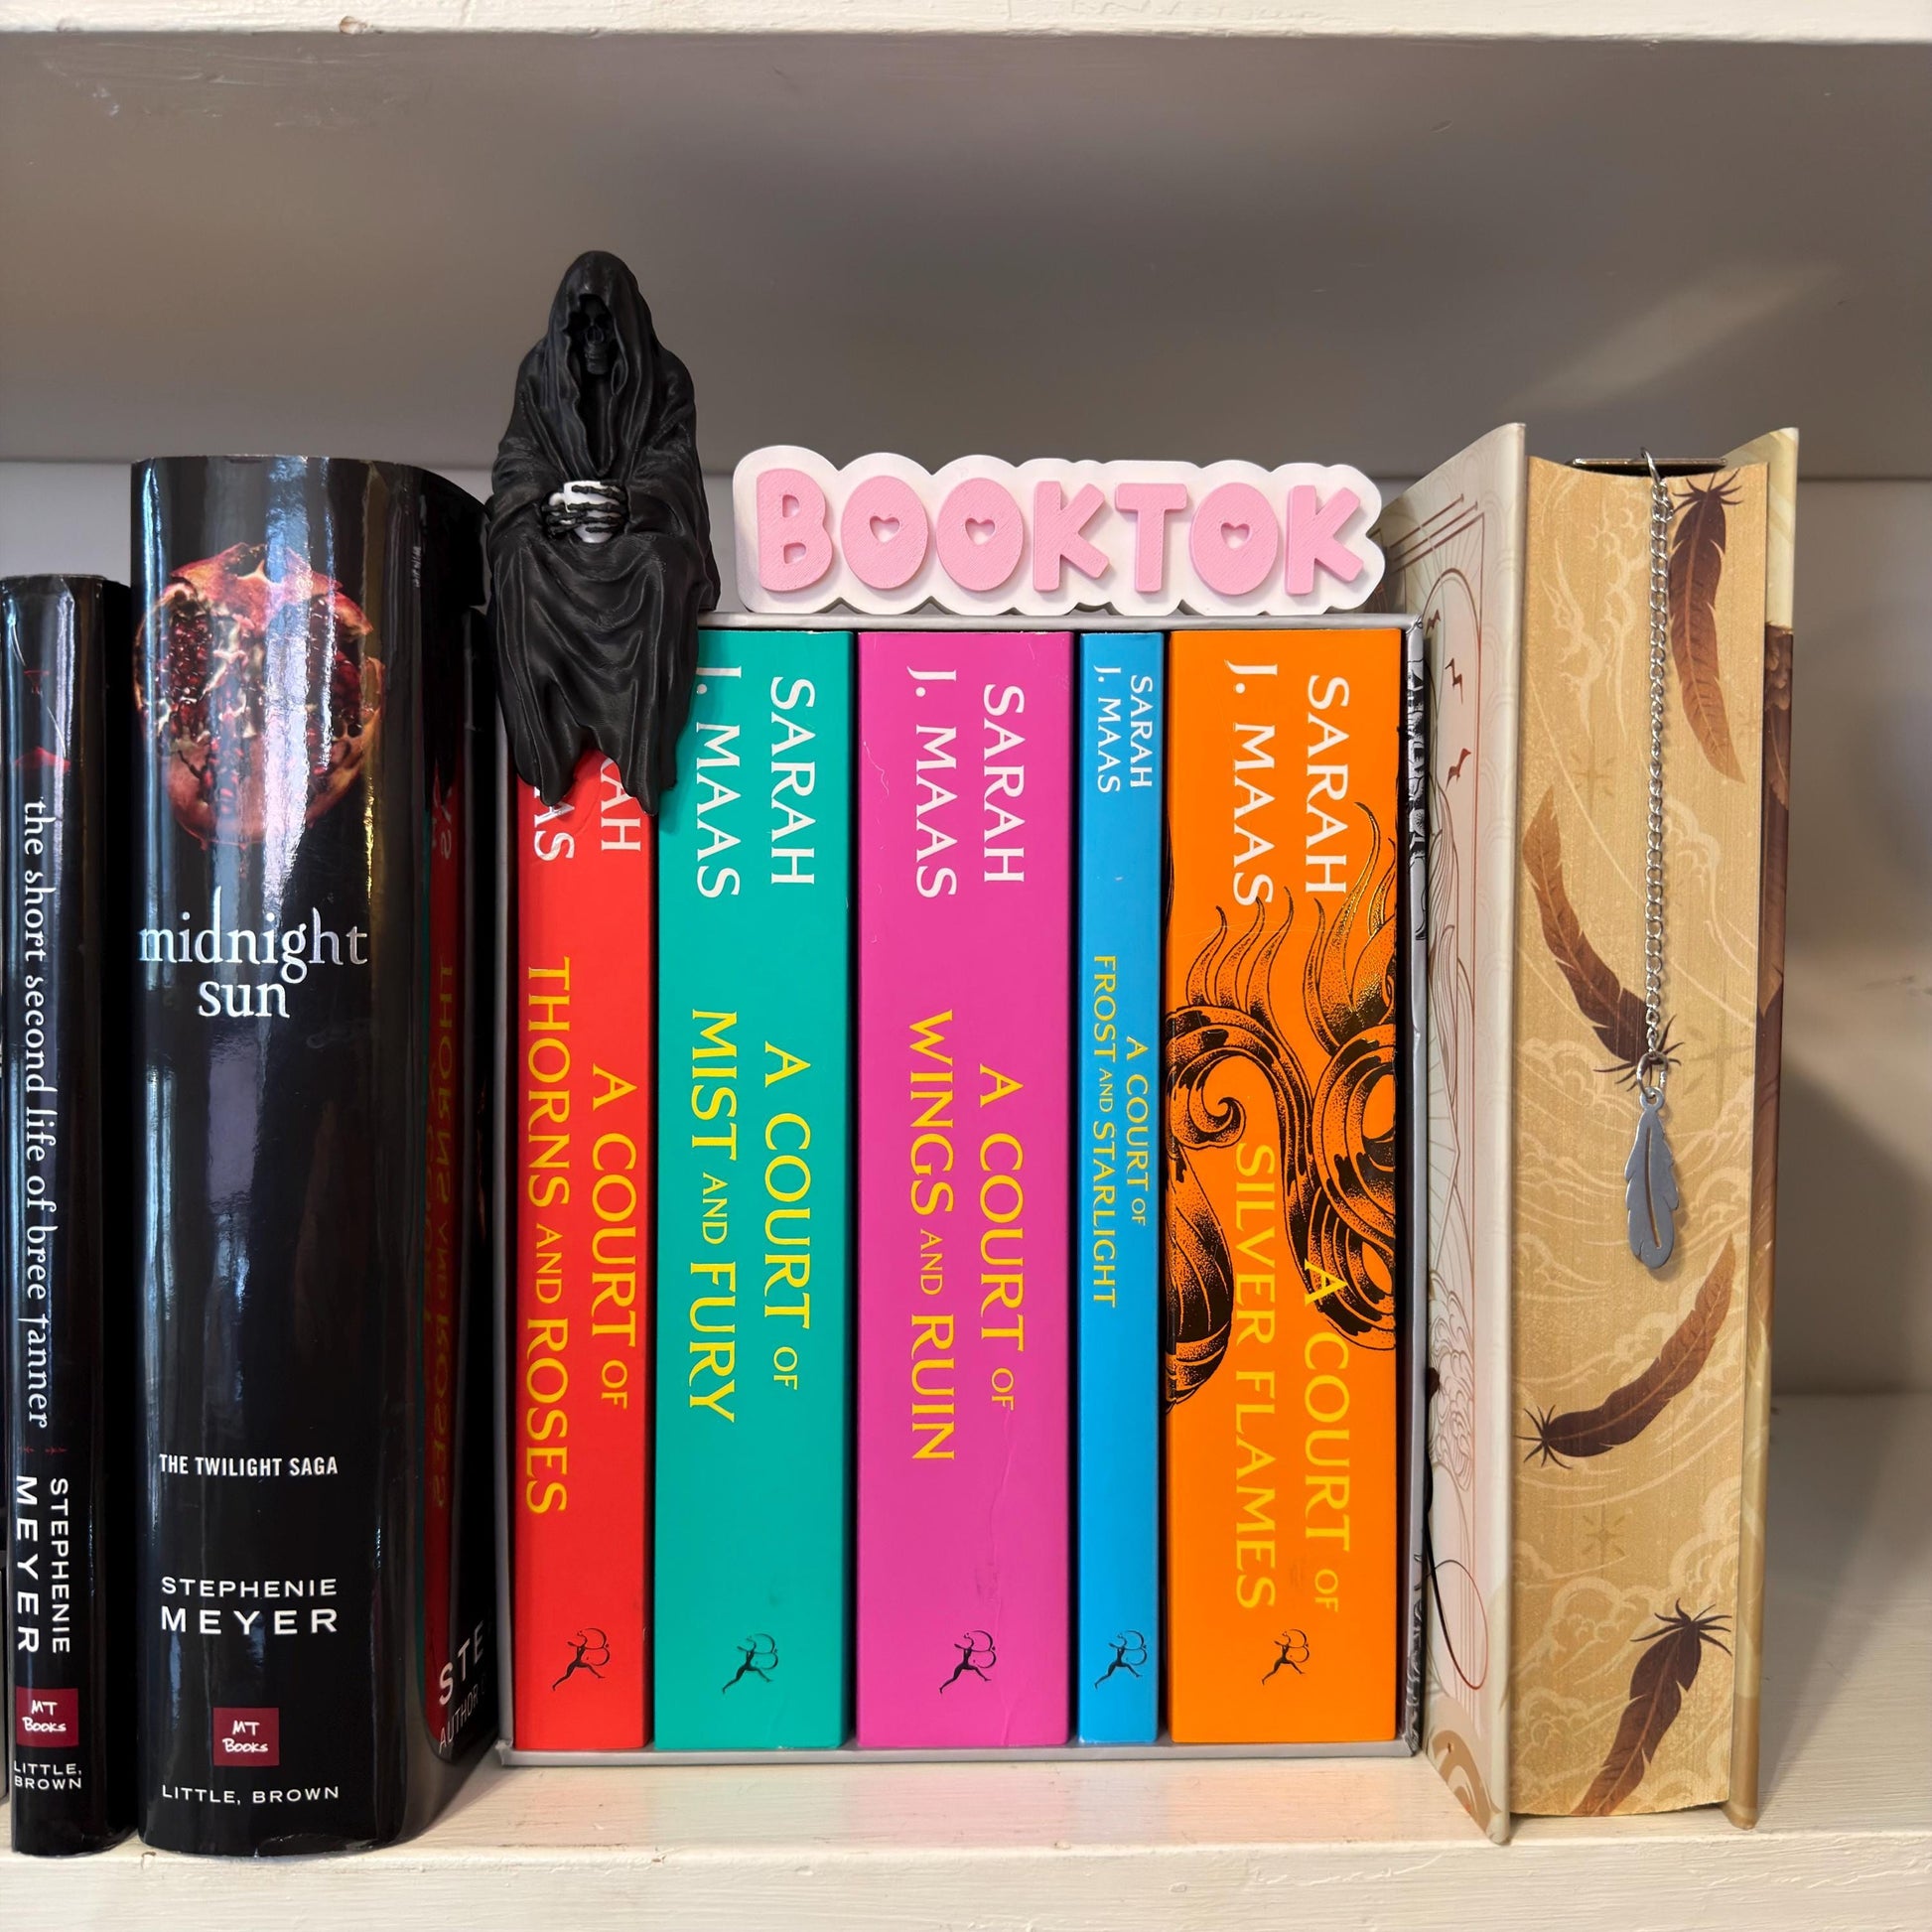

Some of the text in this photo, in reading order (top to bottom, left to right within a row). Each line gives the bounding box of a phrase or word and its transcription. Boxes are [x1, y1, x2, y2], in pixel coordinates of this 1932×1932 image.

[756, 468, 1363, 597] BOOKTOK
[695, 666, 743, 899] J. MAAS
[770, 676, 816, 885] SARAH
[906, 666, 958, 897] J. MAAS
[983, 684, 1026, 882] SARAH
[1094, 666, 1122, 793] J. MAAS
[1130, 674, 1154, 787] SARAH
[1225, 661, 1279, 905] J. MAAS
[1306, 675, 1349, 893] SARAH
[137, 885, 368, 984] midnight
[198, 980, 291, 1020] sun
[17, 797, 59, 1430] the short second life of bree tanner
[1092, 955, 1117, 1308] FROST AND STARLIGHT
[1126, 1035, 1150, 1226] A COURT OF
[526, 956, 571, 1514] THORNS AND ROSES
[591, 1063, 637, 1409] A COURT OF
[689, 1011, 737, 1421] MIST AND FURY
[764, 1042, 811, 1388] A COURT OF
[909, 1010, 955, 1459] WINGS AND RUIN
[979, 1064, 1024, 1407] A COURT OF
[159, 1453, 339, 1477] THE TWILIGHT SAGA
[1235, 1143, 1277, 1608] SILVER FLAMES
[1304, 1260, 1350, 1611] A COURT OF
[16, 1474, 40, 1653] MEYER
[50, 1478, 70, 1654] STEPHENIE
[161, 1576, 337, 1598] STEPHENIE
[161, 1605, 338, 1635] MEYER
[22, 1717, 68, 1733] Books
[31, 1699, 59, 1716] MT
[221, 1737, 269, 1753] Books
[231, 1720, 260, 1735] MT
[439, 1613, 487, 1706] STE
[13, 1758, 82, 1776] LITTLE,
[13, 1774, 82, 1791] BROWN
[162, 1784, 339, 1805] LITTLE, BROWN
